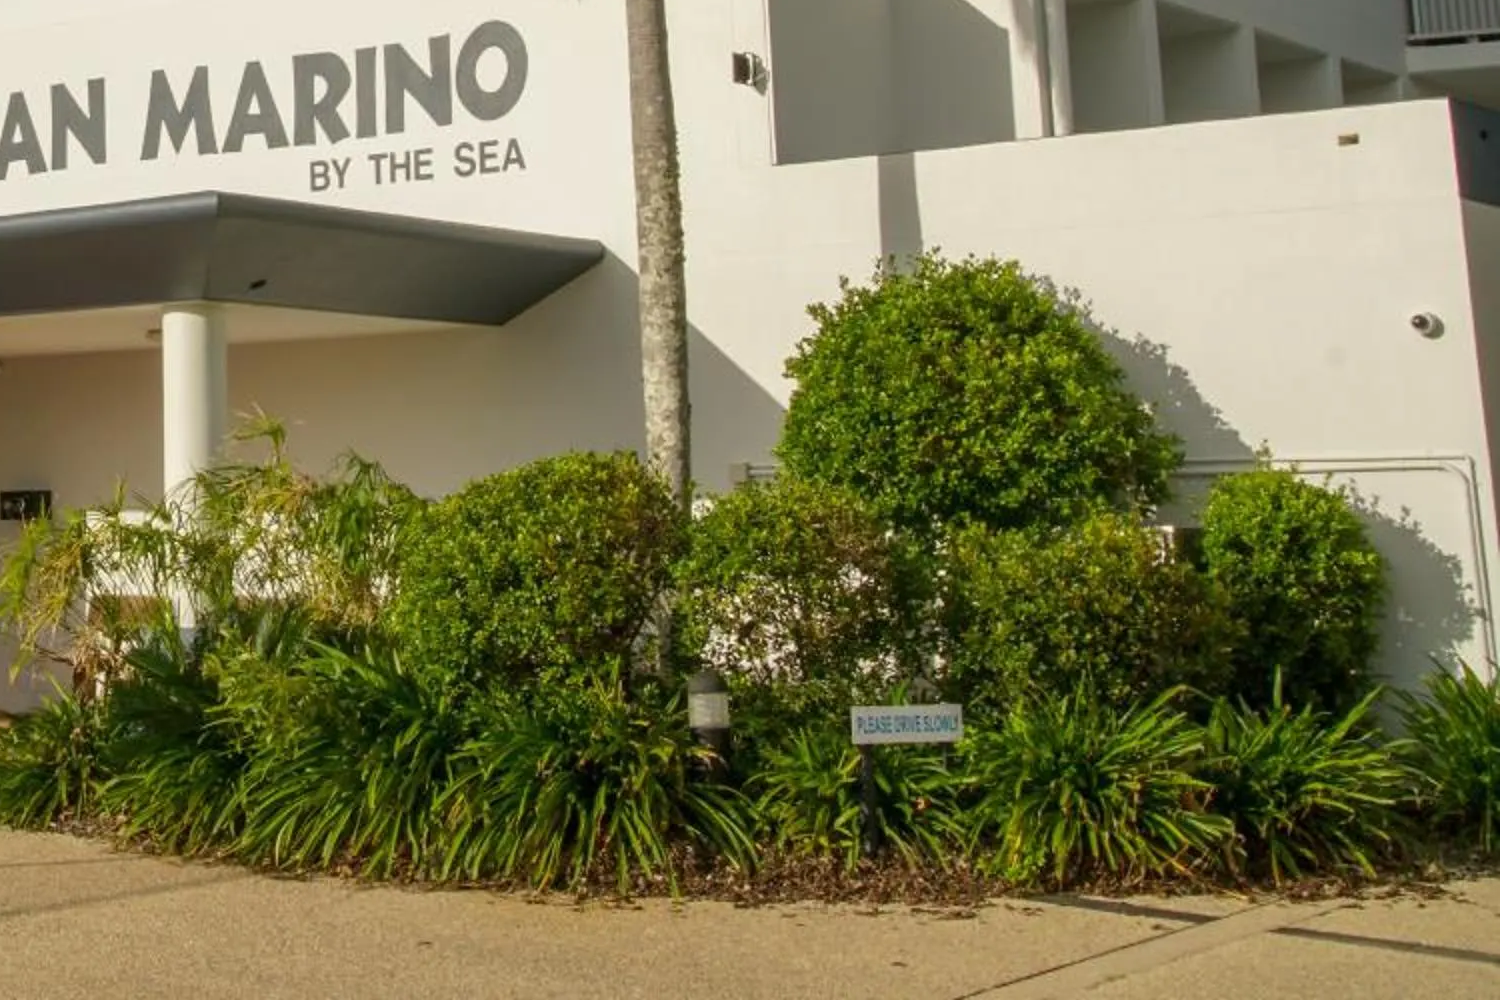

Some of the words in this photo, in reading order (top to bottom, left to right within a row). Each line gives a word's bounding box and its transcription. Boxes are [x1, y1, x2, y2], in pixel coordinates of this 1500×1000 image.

[140, 20, 529, 161] MARINO
[309, 157, 352, 192] BY
[368, 147, 435, 185] THE
[453, 138, 527, 178] SEA
[856, 715, 892, 735] PLEASE
[894, 714, 921, 734] DRIVE
[923, 713, 959, 733] SLOWLY
